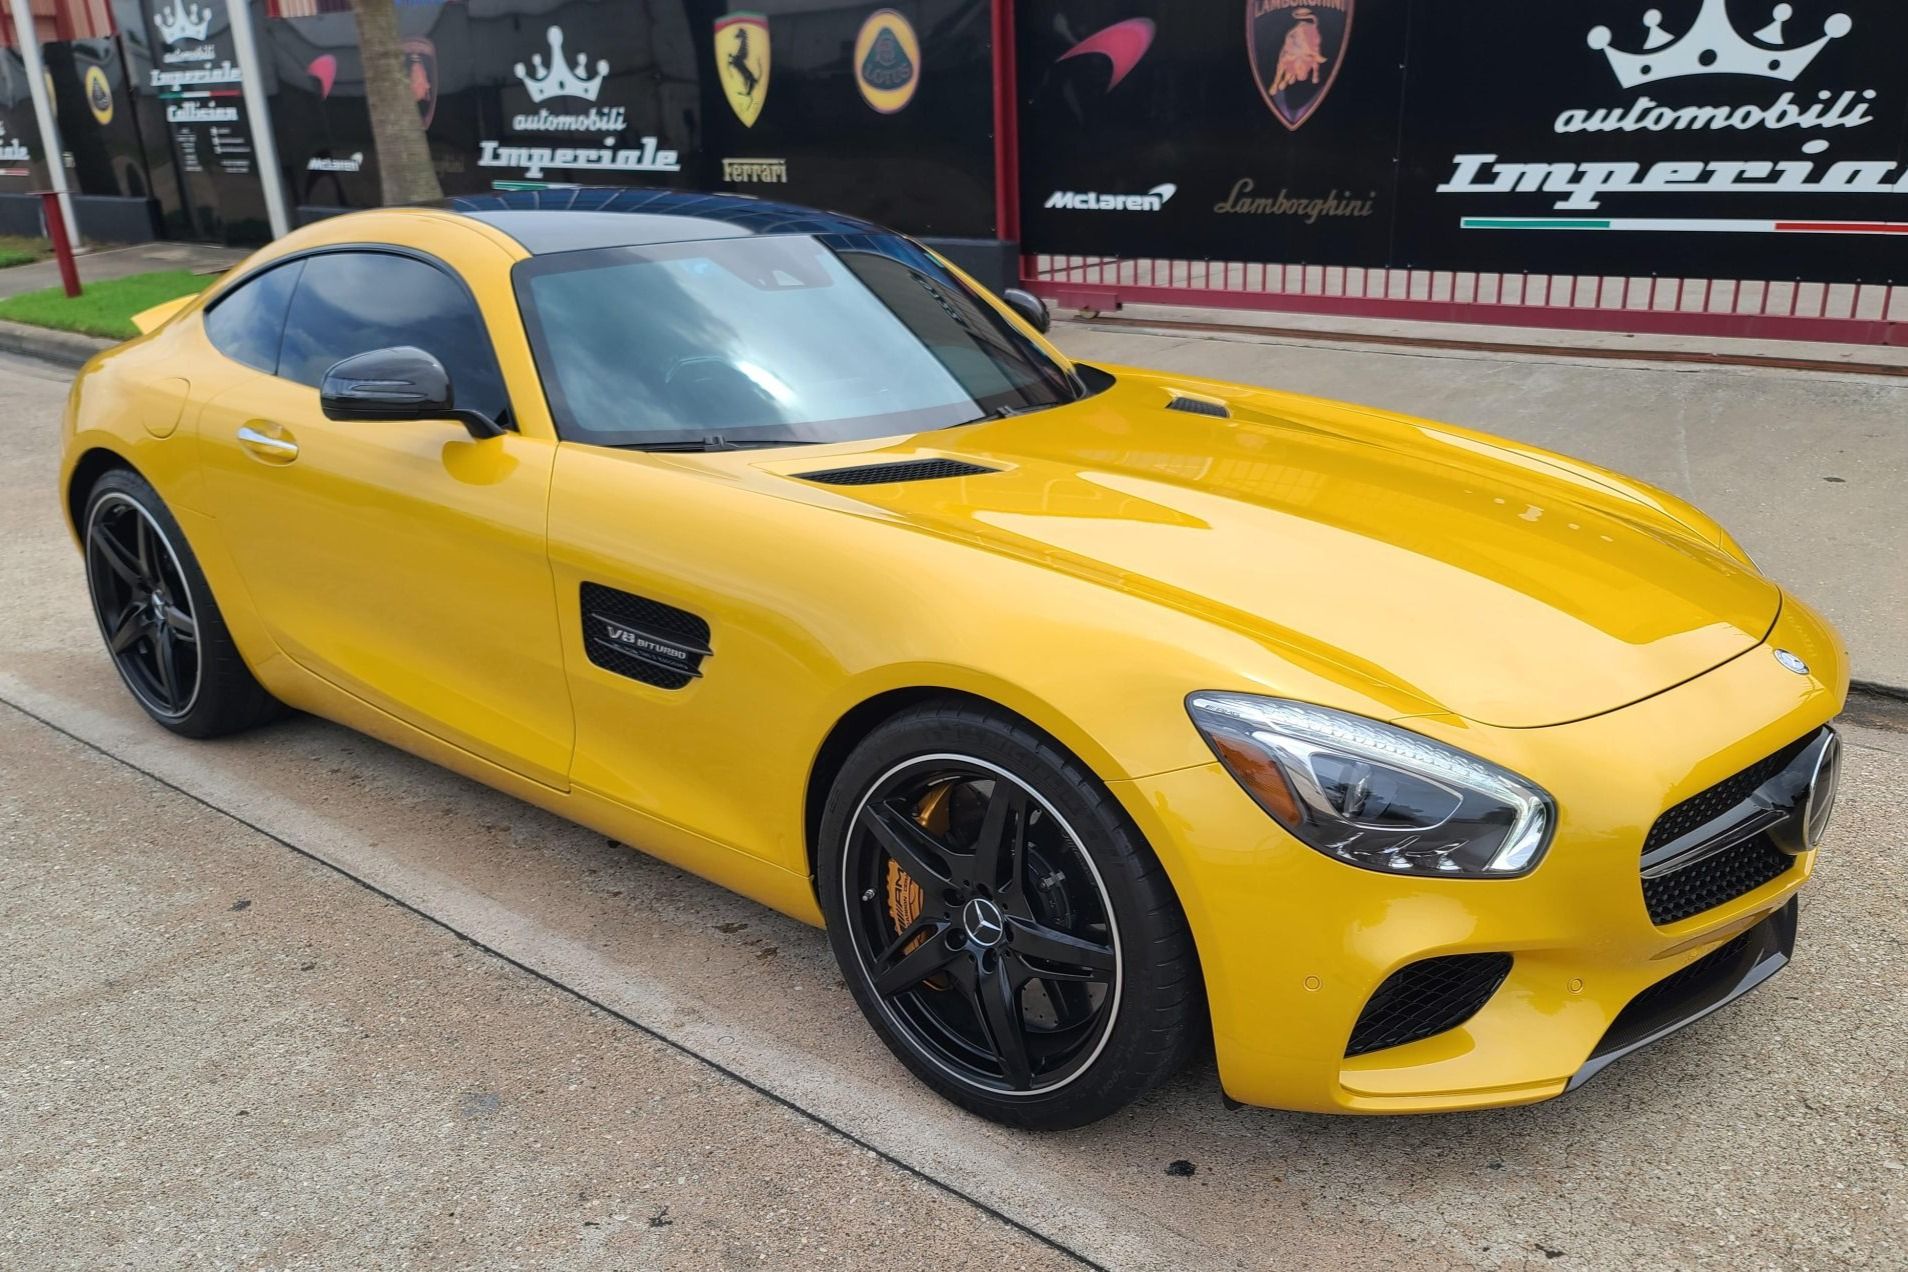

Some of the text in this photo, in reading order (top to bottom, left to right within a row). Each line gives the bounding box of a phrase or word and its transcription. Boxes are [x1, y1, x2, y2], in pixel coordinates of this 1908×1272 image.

[513, 106, 628, 131] automobili
[1553, 89, 1877, 133] automobili
[306, 156, 360, 171] McLaren
[477, 136, 681, 179] Imperiale
[722, 158, 787, 182] Ferrari
[1435, 139, 1908, 210] Imperia
[1044, 190, 1164, 211] McLaren
[1213, 177, 1377, 224] Lamborghini
[606, 626, 686, 660] V8 BITURBO
